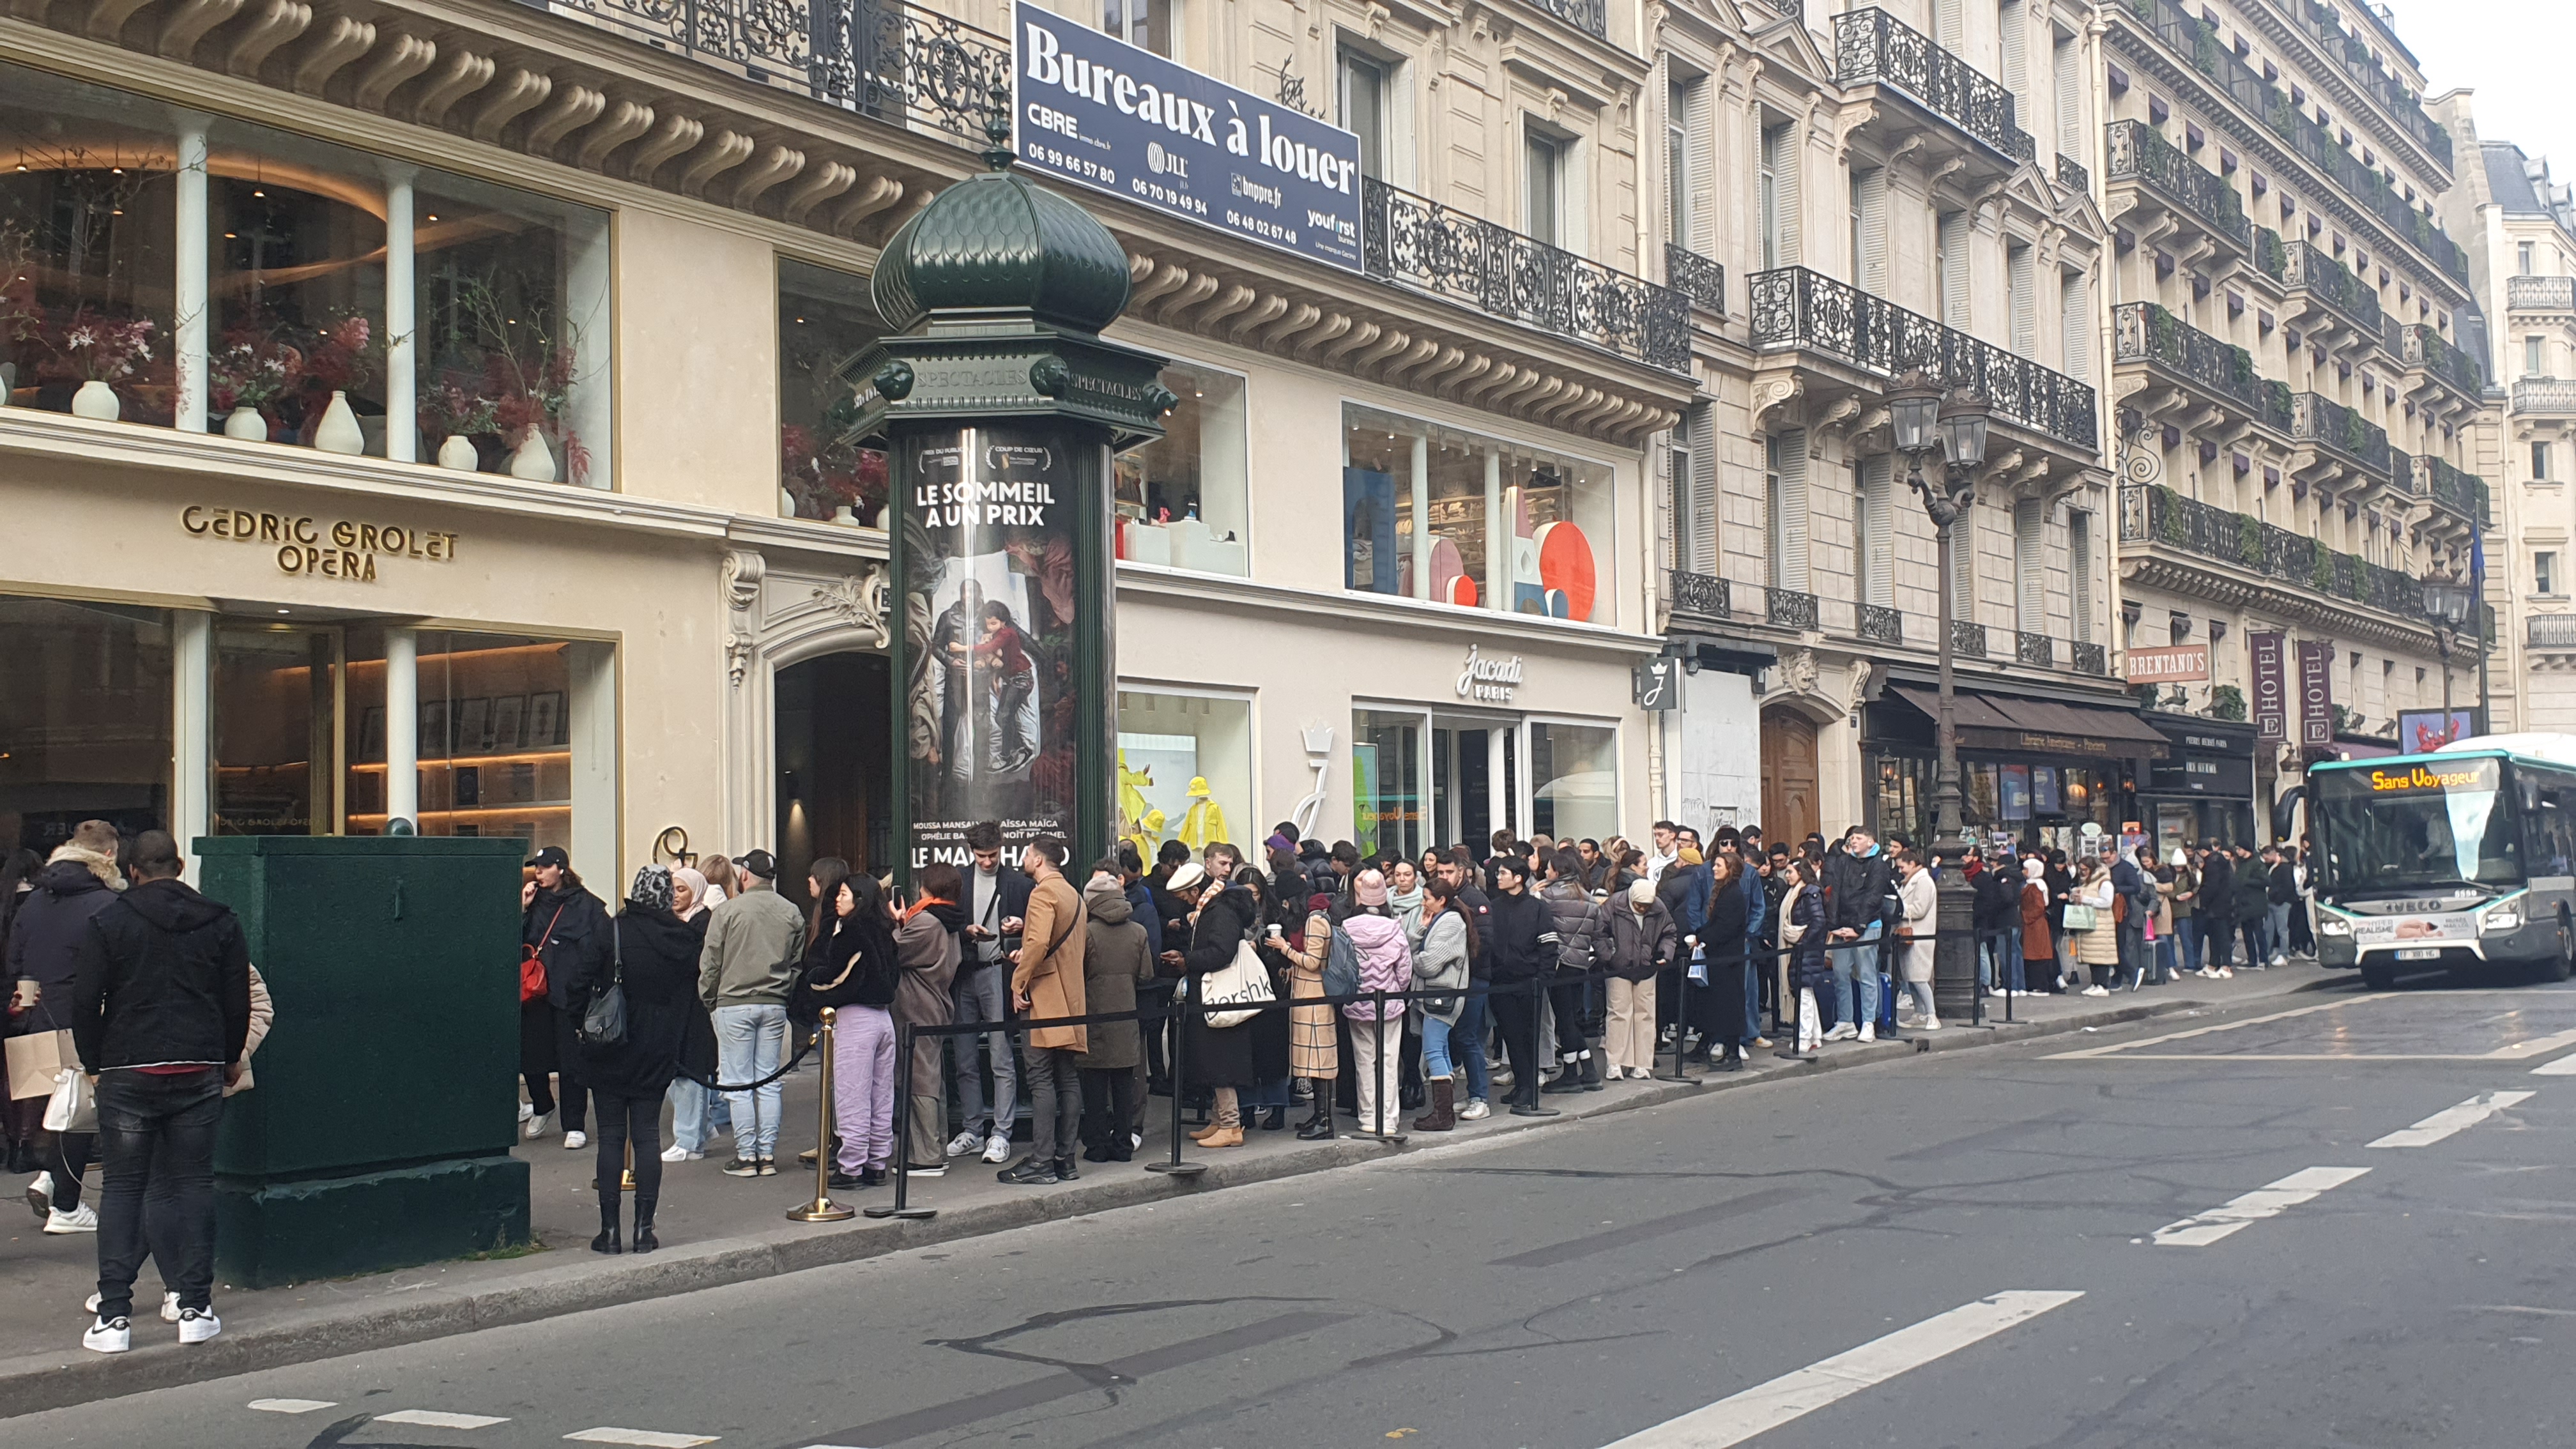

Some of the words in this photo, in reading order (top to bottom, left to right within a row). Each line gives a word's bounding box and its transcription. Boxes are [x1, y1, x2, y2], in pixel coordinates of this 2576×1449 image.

[1025, 22, 1217, 146] Bureaux
[1227, 98, 1249, 157] à
[1259, 114, 1355, 195] louer
[1027, 103, 1078, 139] CBRE
[1029, 142, 1045, 161] 06
[1047, 149, 1062, 167] 99
[1066, 155, 1080, 172] 66
[1084, 160, 1098, 178] 57
[1100, 166, 1115, 184] 80
[1165, 153, 1188, 178] JLL
[1132, 178, 1147, 195] 06
[1149, 183, 1163, 201] 70
[1165, 188, 1177, 205] 19
[1179, 194, 1193, 210] 49
[1195, 199, 1208, 216] 94
[1243, 176, 1282, 210] bnppre.fr
[1227, 210, 1240, 227] 06
[1242, 215, 1254, 231] 48
[1256, 219, 1269, 236] 02
[1271, 224, 1283, 240] 67
[1285, 229, 1297, 245] 48
[1307, 209, 1356, 238] youfirst
[917, 371, 1027, 388] SPECTACLES
[1071, 373, 1142, 401] SPECTACLES
[917, 485, 939, 507] LE
[942, 481, 1055, 505] SOMMEIL
[925, 507, 942, 528] A
[945, 504, 981, 526] UN
[986, 504, 1045, 526] PRIX
[332, 520, 459, 559] GROLET
[2128, 652, 2205, 676] BRENTANO'S
[2258, 639, 2278, 710] HOTEL
[1475, 684, 1513, 700] PARIS
[2306, 649, 2325, 717] HOTEL
[2372, 771, 2409, 791] Sans
[2411, 767, 2480, 788] Voyageur
[999, 818, 1027, 827] AÏSSA
[1029, 818, 1059, 827] MAÏGA
[921, 832, 952, 841] OPHÉLIE
[952, 832, 968, 840] BA
[912, 847, 929, 868] LE
[2386, 900, 2442, 912] IVECO
